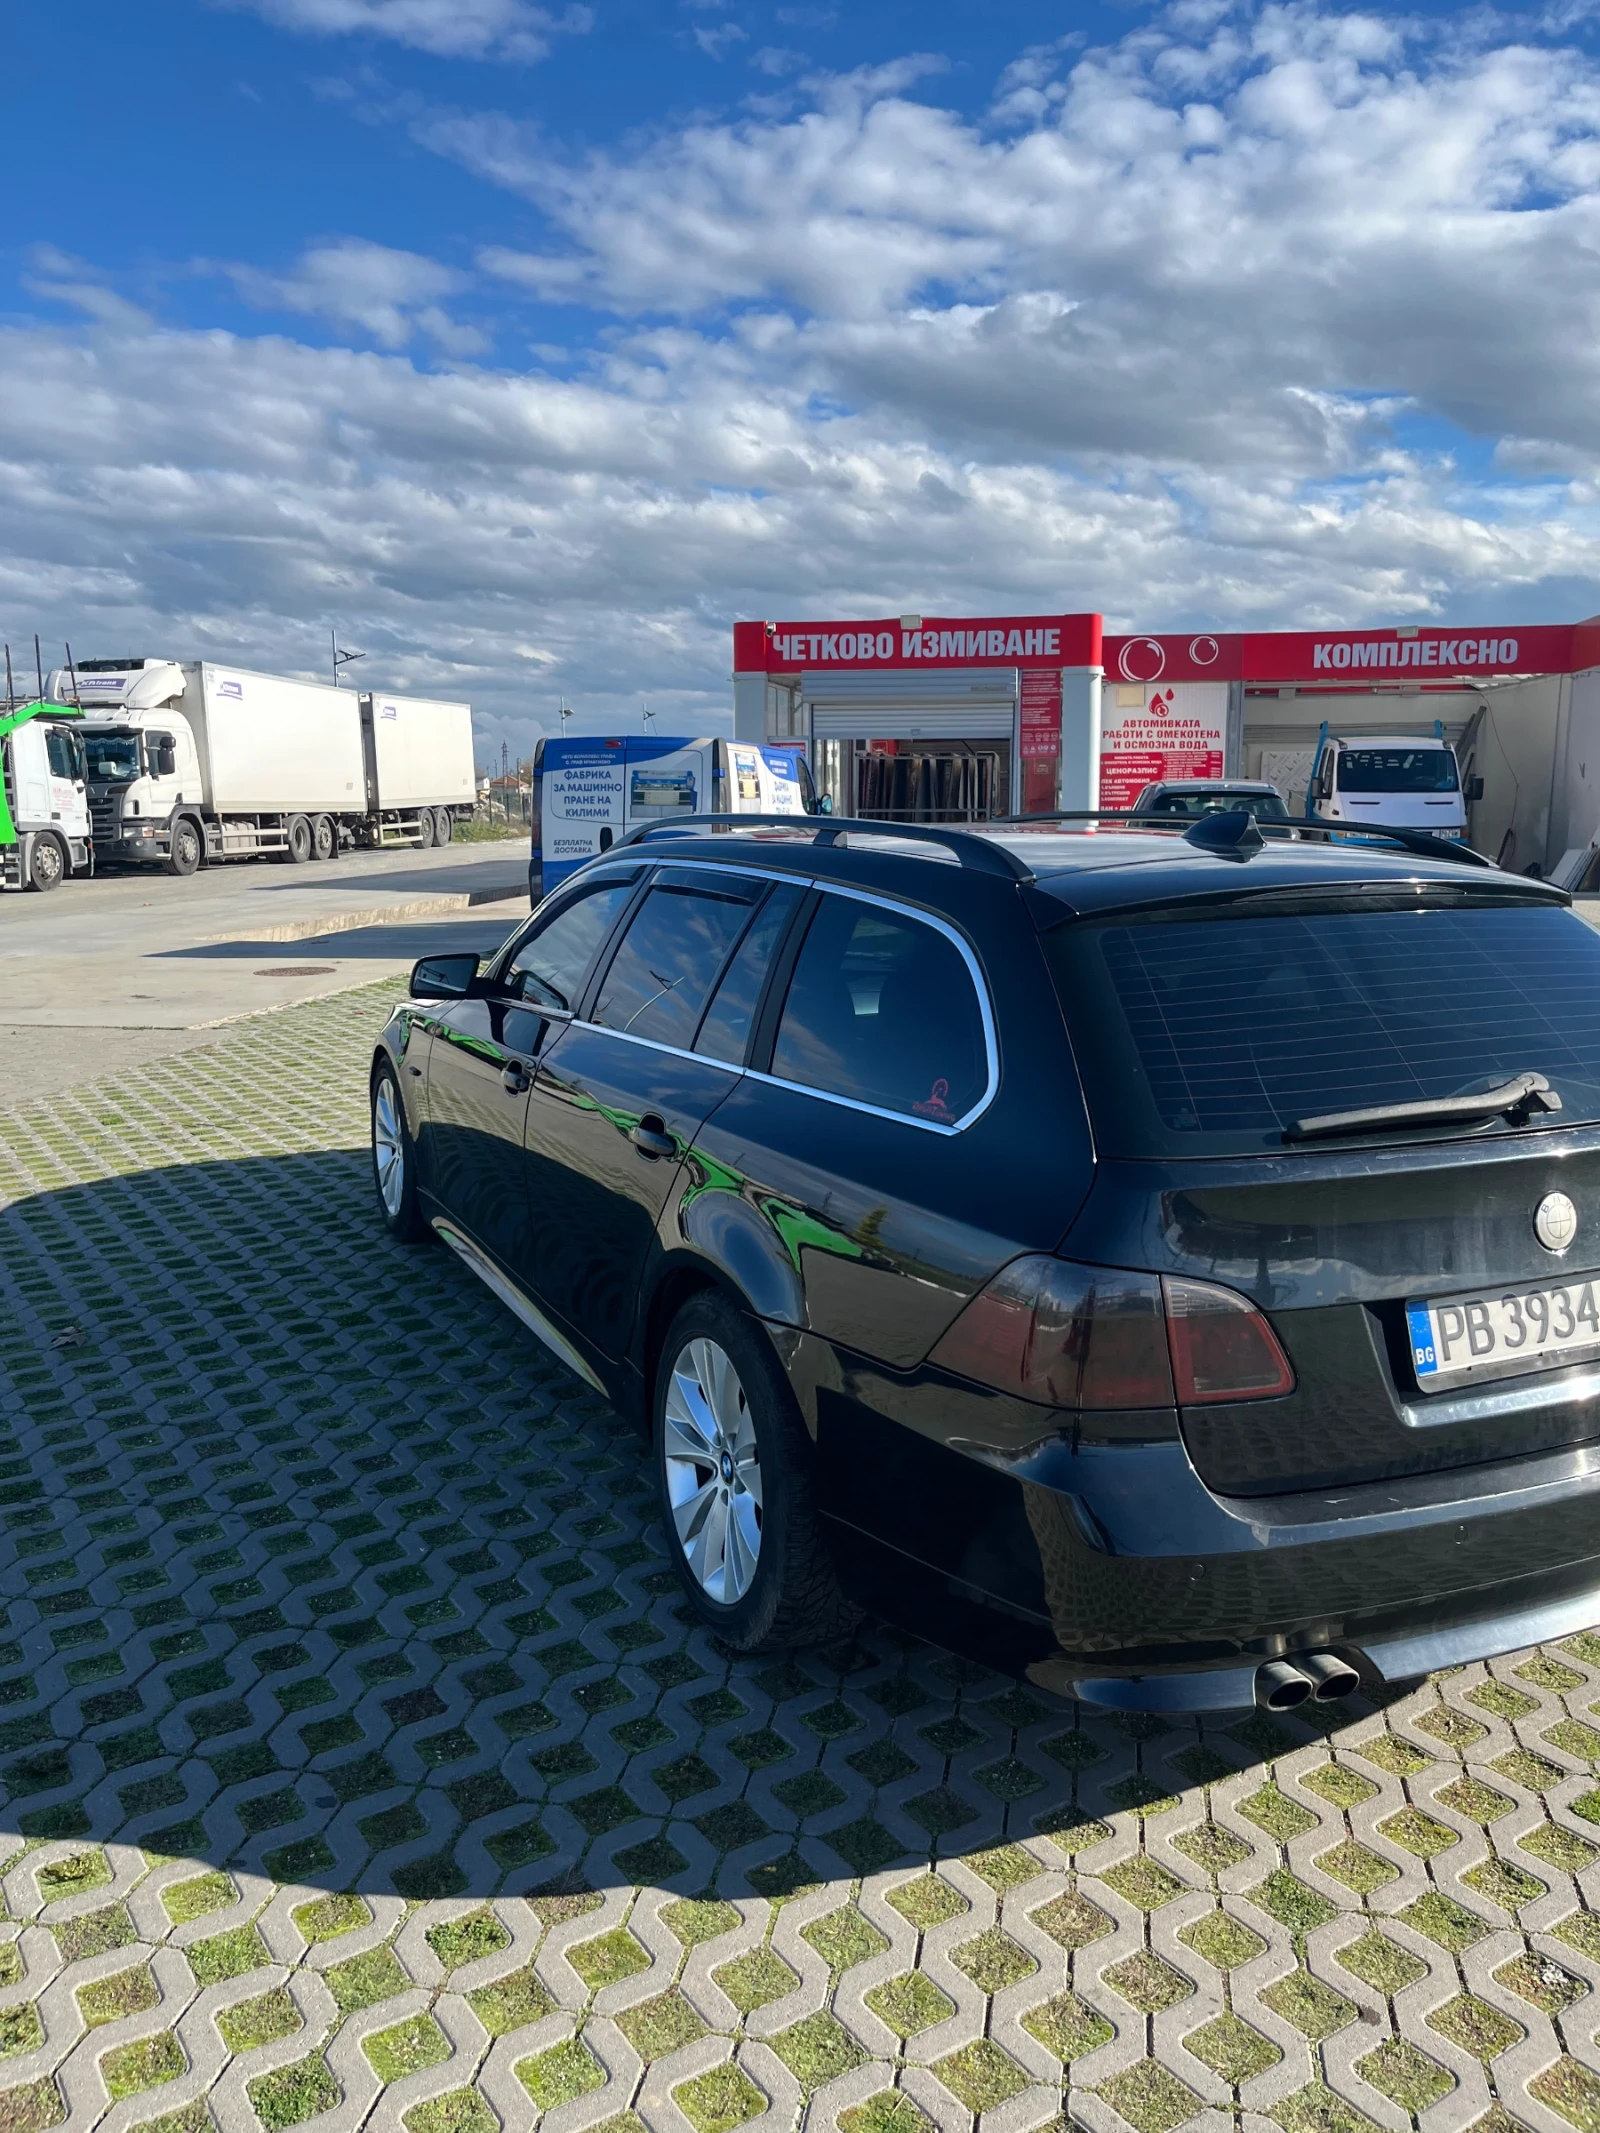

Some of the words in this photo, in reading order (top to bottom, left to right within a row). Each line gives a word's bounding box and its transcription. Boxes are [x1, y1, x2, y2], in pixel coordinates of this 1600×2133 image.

[773, 632, 894, 660] ЧЕТКОВО
[902, 628, 1061, 658] ИЗМИВАНЕ
[1313, 638, 1519, 668] КОМПЛЕКСНО
[1123, 719, 1201, 728] АВТОМИВКАТА
[1102, 730, 1143, 739] РАБОТИ
[1146, 730, 1153, 738] С
[1156, 730, 1220, 738] ОМЕКОТЕНА
[1113, 741, 1121, 749] И
[1124, 741, 1175, 749] ОСМОЗНА
[1179, 740, 1208, 750] ВОДА
[564, 770, 612, 780] ФАБРИКА
[1106, 767, 1158, 775] ЦЕНОРАЗПИС
[553, 784, 565, 792] ЗА
[567, 783, 622, 792] МАШИННО
[563, 796, 595, 805] ПРАНЕ
[597, 796, 612, 805] НА
[565, 808, 610, 817] КИЛИМИ
[553, 839, 593, 847] БЕЗПЛАТНА
[554, 847, 592, 855] ДОСТАВКА
[1416, 1348, 1434, 1365] BG
